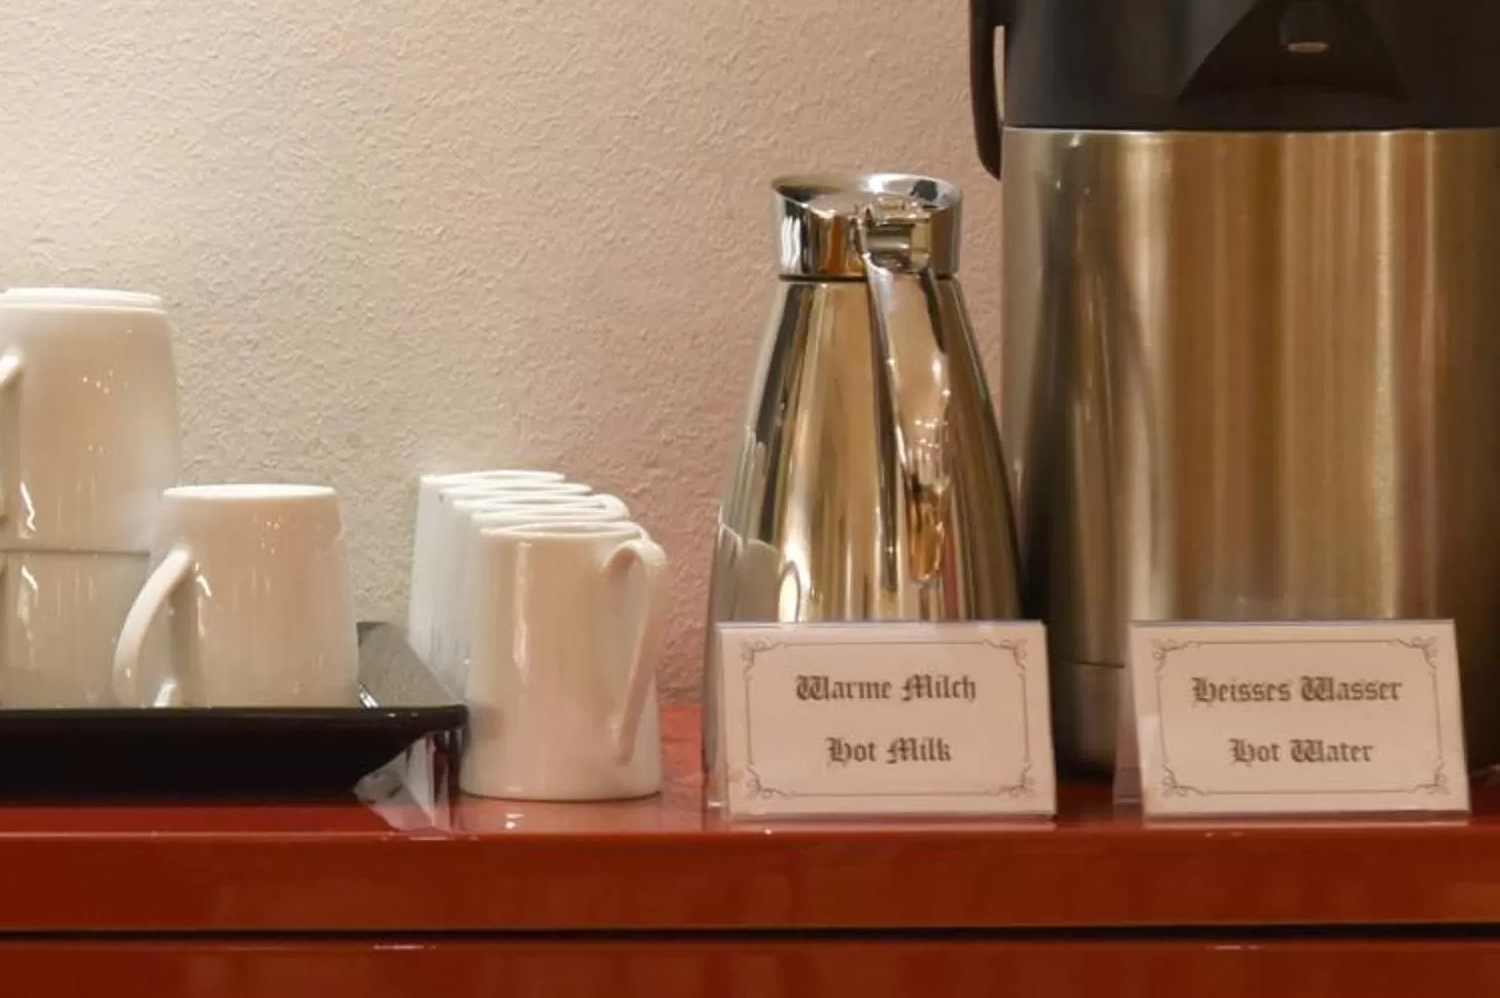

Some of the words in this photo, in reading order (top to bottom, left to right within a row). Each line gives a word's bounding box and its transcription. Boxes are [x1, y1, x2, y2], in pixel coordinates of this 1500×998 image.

[795, 674, 892, 701] Warme
[901, 673, 977, 702] Milch
[1191, 676, 1292, 704] Heisses
[1300, 675, 1403, 702] Wasser
[826, 737, 877, 766] Hot
[886, 737, 952, 765] Milk
[1228, 738, 1281, 767] Hot
[1289, 738, 1374, 764] Water
